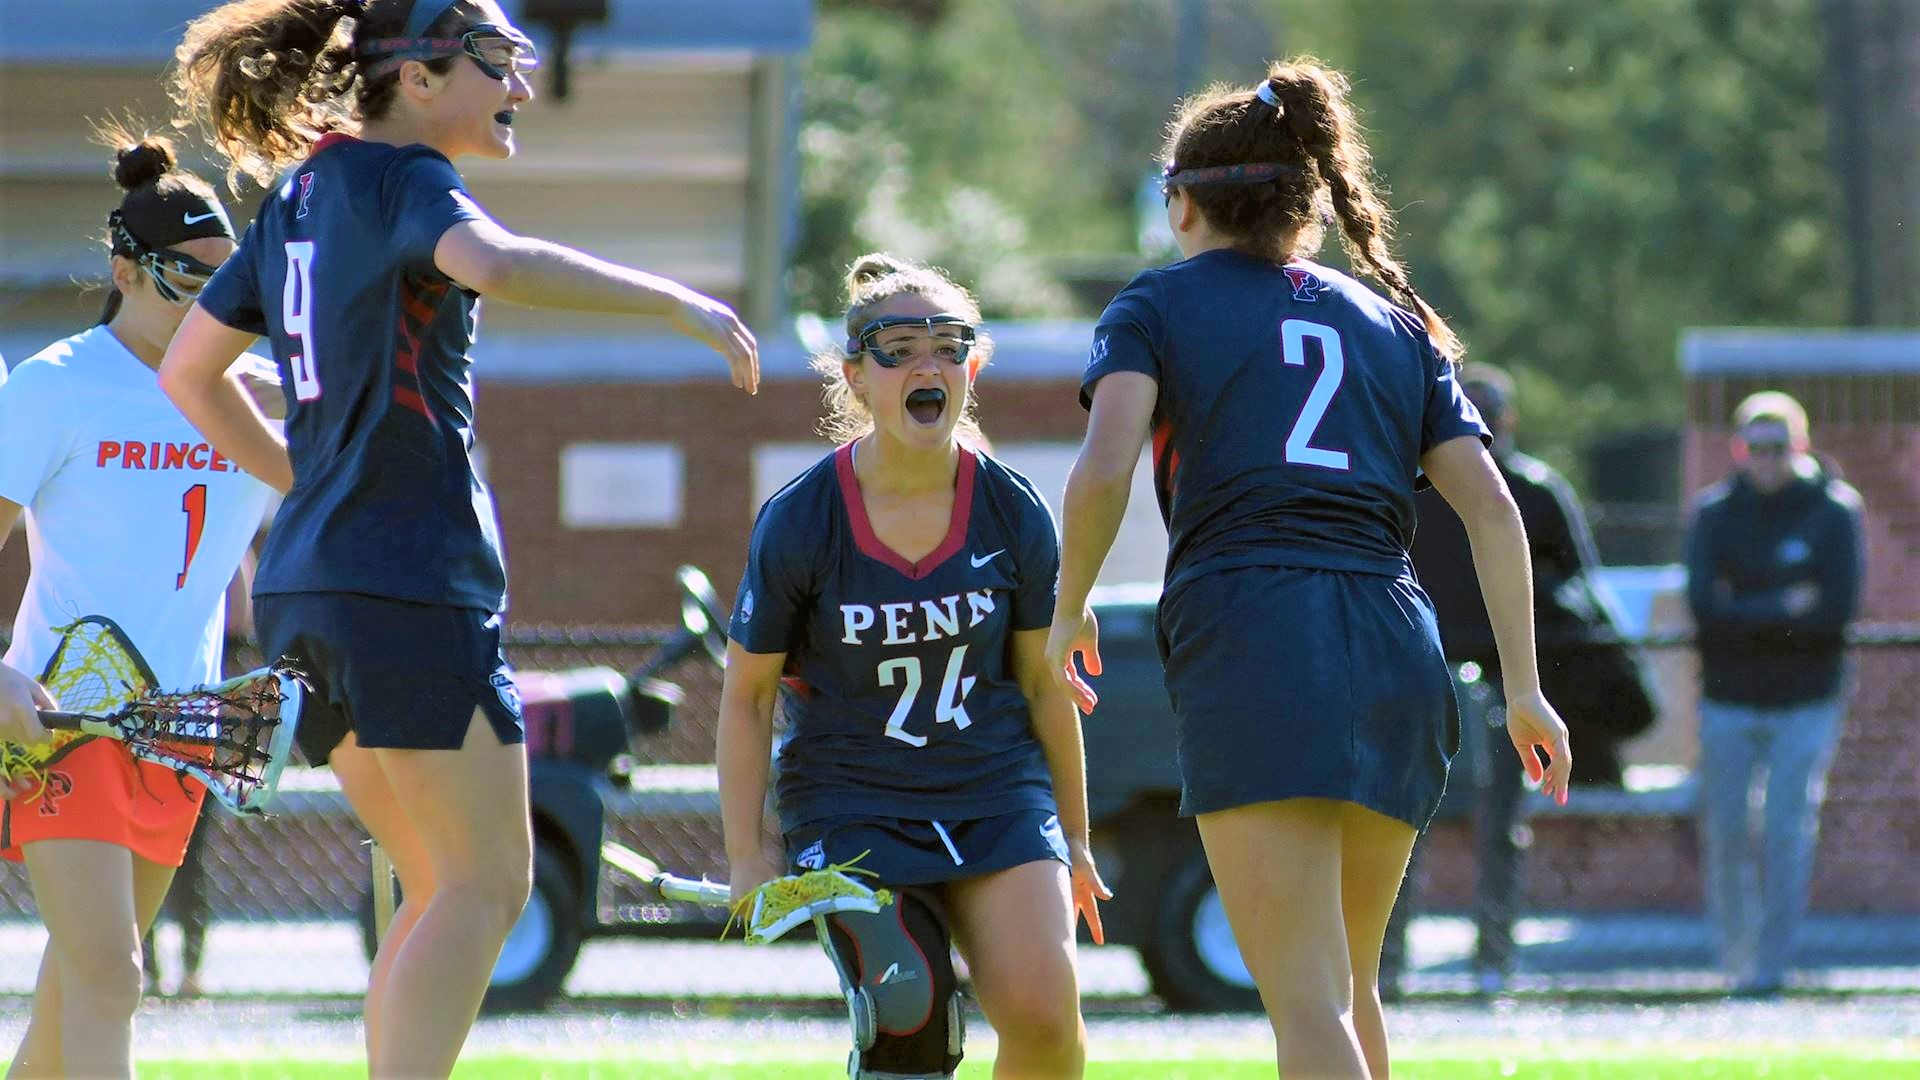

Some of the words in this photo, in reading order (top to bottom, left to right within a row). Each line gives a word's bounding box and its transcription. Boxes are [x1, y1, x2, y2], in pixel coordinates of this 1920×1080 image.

[283, 240, 322, 402] 9
[1283, 268, 1319, 301] P
[1281, 318, 1349, 471] 2
[97, 440, 239, 473] PRINCE
[176, 483, 207, 591] 1
[839, 588, 996, 644] PENN
[877, 644, 977, 748] 24
[39, 771, 73, 817] P
